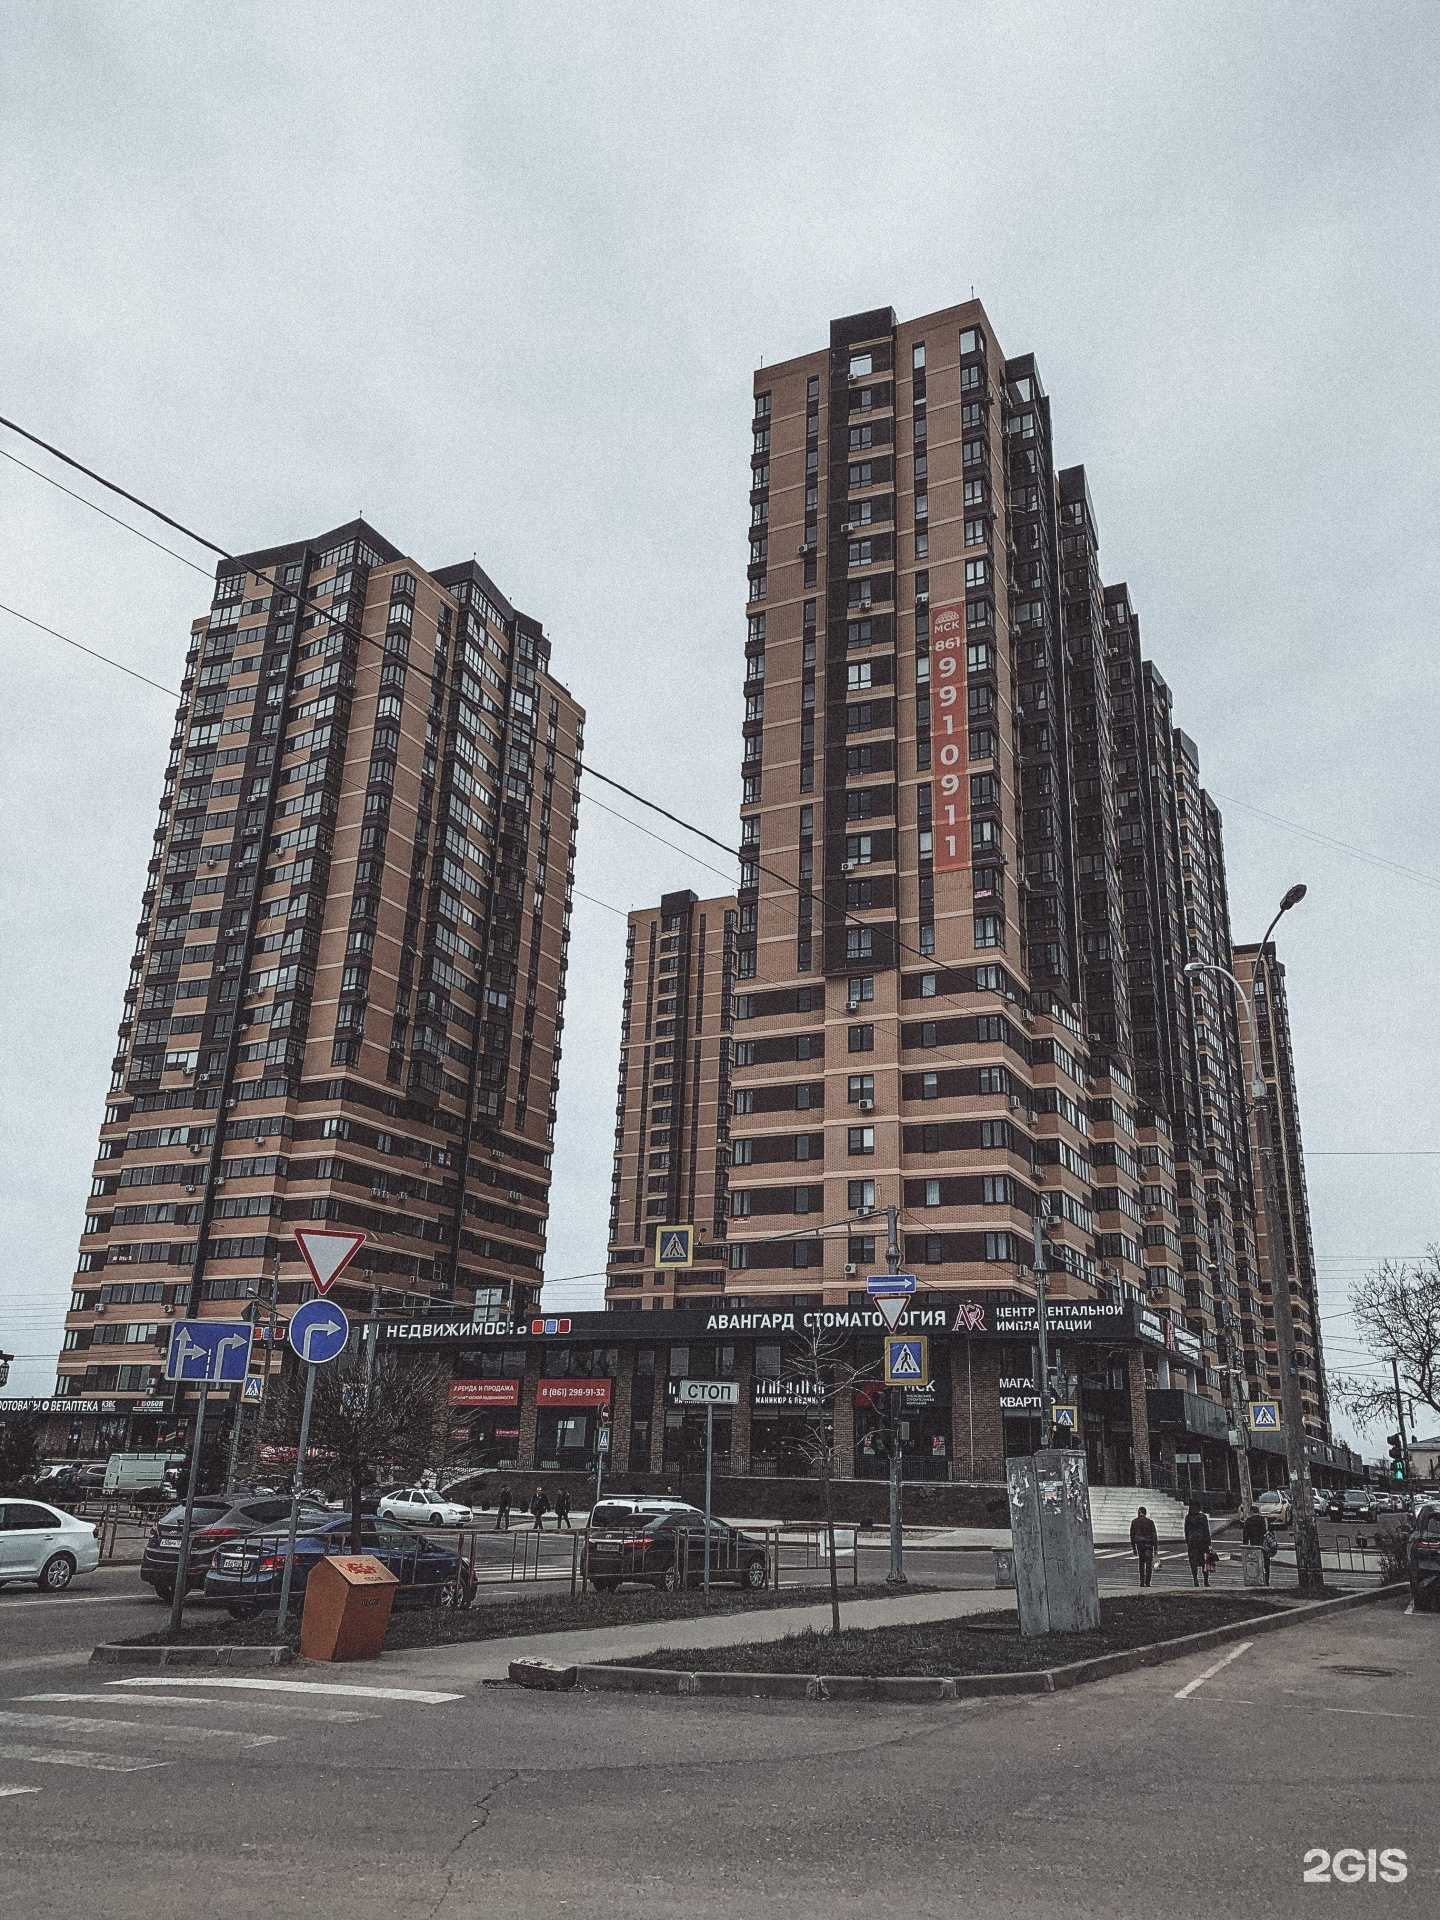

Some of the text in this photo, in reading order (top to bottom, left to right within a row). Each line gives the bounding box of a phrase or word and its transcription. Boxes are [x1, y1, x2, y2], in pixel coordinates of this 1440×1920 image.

[934, 621, 960, 634] МСК
[935, 637, 961, 652] 861
[996, 1305, 1124, 1319] ЦЕНТР ЕНТАЛЬНОЙ
[706, 1310, 946, 1331] АВАНГАРД СТОМАТООГИЯ
[687, 1384, 731, 1400] СТОП
[50, 1400, 99, 1411] ВЕТАПТЕКА
